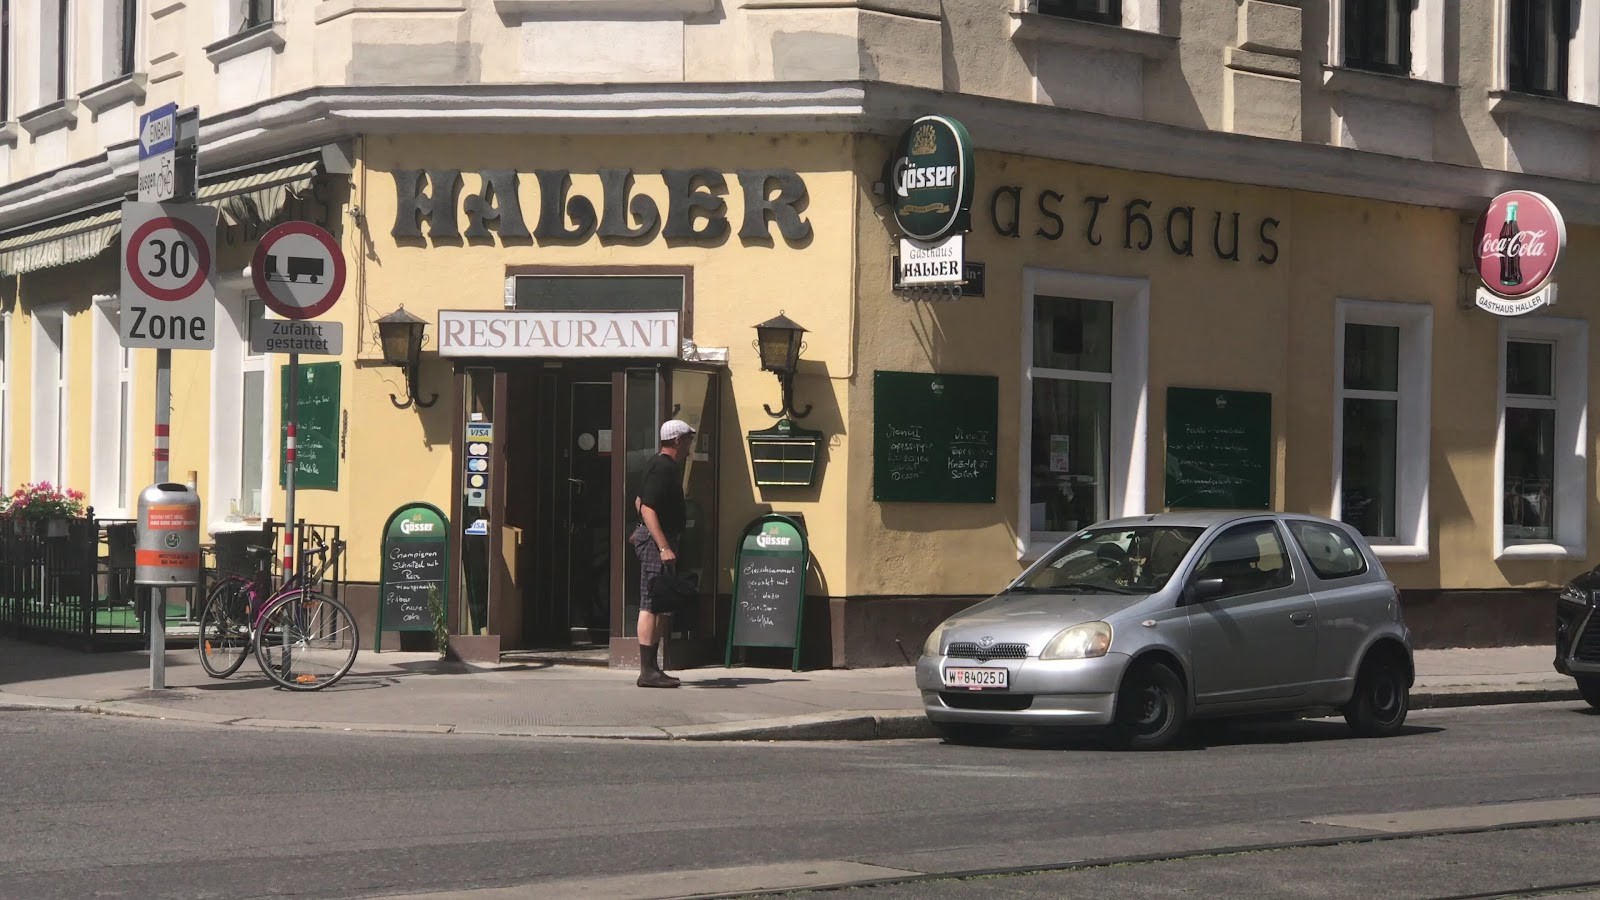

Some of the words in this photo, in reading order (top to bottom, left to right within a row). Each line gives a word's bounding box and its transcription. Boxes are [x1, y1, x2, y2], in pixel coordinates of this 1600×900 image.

[150, 117, 171, 143] EINBAHN
[893, 156, 958, 198] Gösser
[390, 167, 814, 250] HALLER
[1478, 229, 1548, 259] Coca-Cola
[148, 239, 190, 278] 30
[909, 246, 953, 260] Gasthaus
[904, 261, 959, 278] HALLER
[1478, 296, 1514, 313] GASTHAUS
[1515, 295, 1542, 312] HALLER
[129, 306, 206, 341] Zone
[273, 322, 323, 336] Zufahrt
[442, 318, 676, 348] RESTAURANT
[266, 337, 328, 351] gestattet
[470, 428, 489, 437] VISA
[400, 519, 435, 535] Gösser
[756, 531, 791, 548] Gösser
[949, 671, 956, 683] W
[964, 671, 996, 684] 84025
[998, 671, 1005, 684] D
